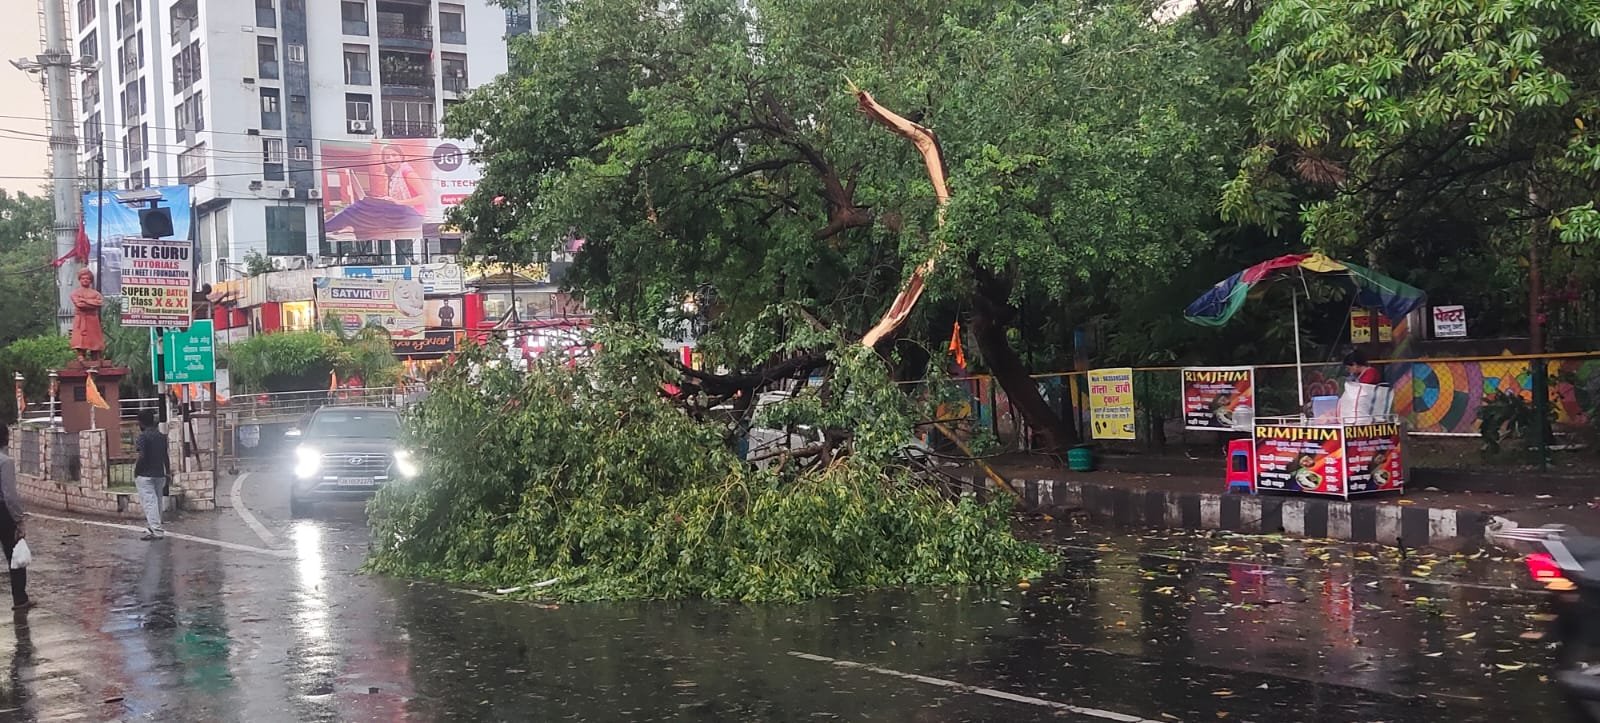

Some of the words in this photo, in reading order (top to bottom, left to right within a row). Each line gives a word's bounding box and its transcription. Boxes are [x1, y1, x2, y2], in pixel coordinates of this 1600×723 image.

[452, 180, 474, 188] TECH
[122, 245, 147, 259] THE
[151, 246, 188, 260] GURU
[132, 260, 179, 269] TUTORIALS
[135, 270, 148, 278] NEET
[153, 270, 188, 278] FOUNDATION
[121, 286, 149, 297] SUPER
[151, 287, 163, 297] 30
[332, 288, 370, 298] SATVIK
[372, 289, 388, 299] IVF
[130, 297, 152, 306] Class
[155, 297, 163, 307] X
[165, 298, 174, 307] &
[1184, 371, 1247, 383] RIMJHIM
[1256, 426, 1337, 440] RIMJHIM
[1345, 424, 1398, 439] RIMJHIM
